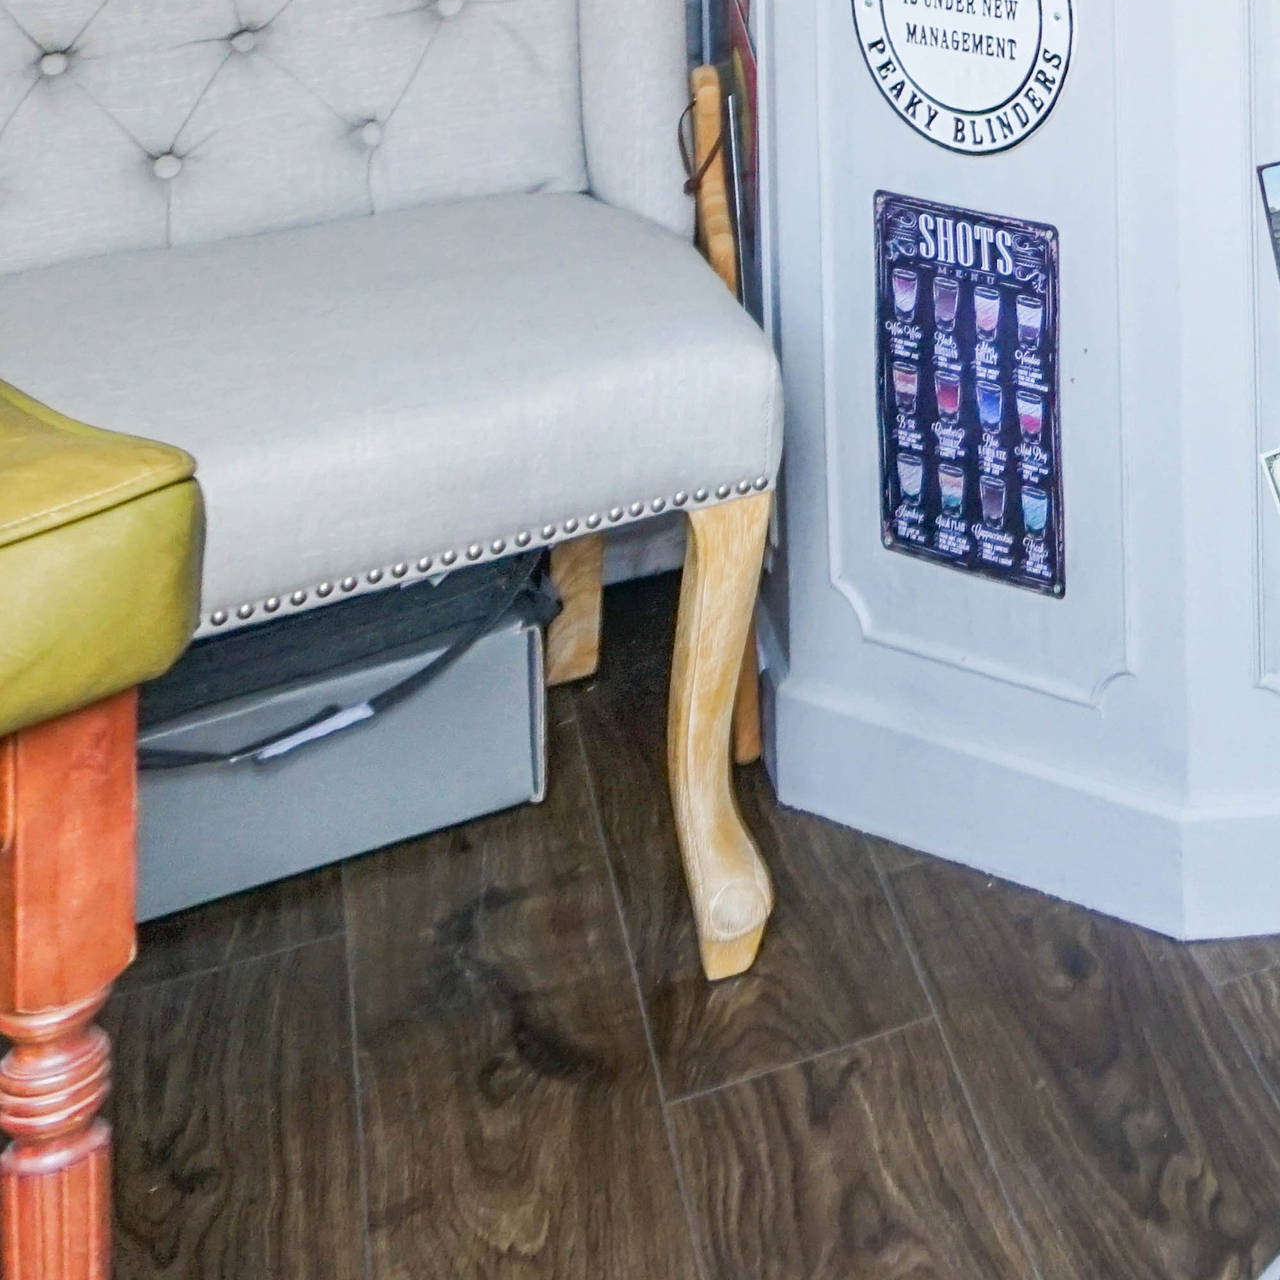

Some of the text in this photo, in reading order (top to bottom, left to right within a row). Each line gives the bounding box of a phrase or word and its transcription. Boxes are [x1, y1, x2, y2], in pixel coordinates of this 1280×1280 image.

[905, 21, 1018, 61] MANAGEMENT
[867, 37, 1063, 146] PEAKY BLINDERS
[918, 212, 1015, 277] SHOTS
